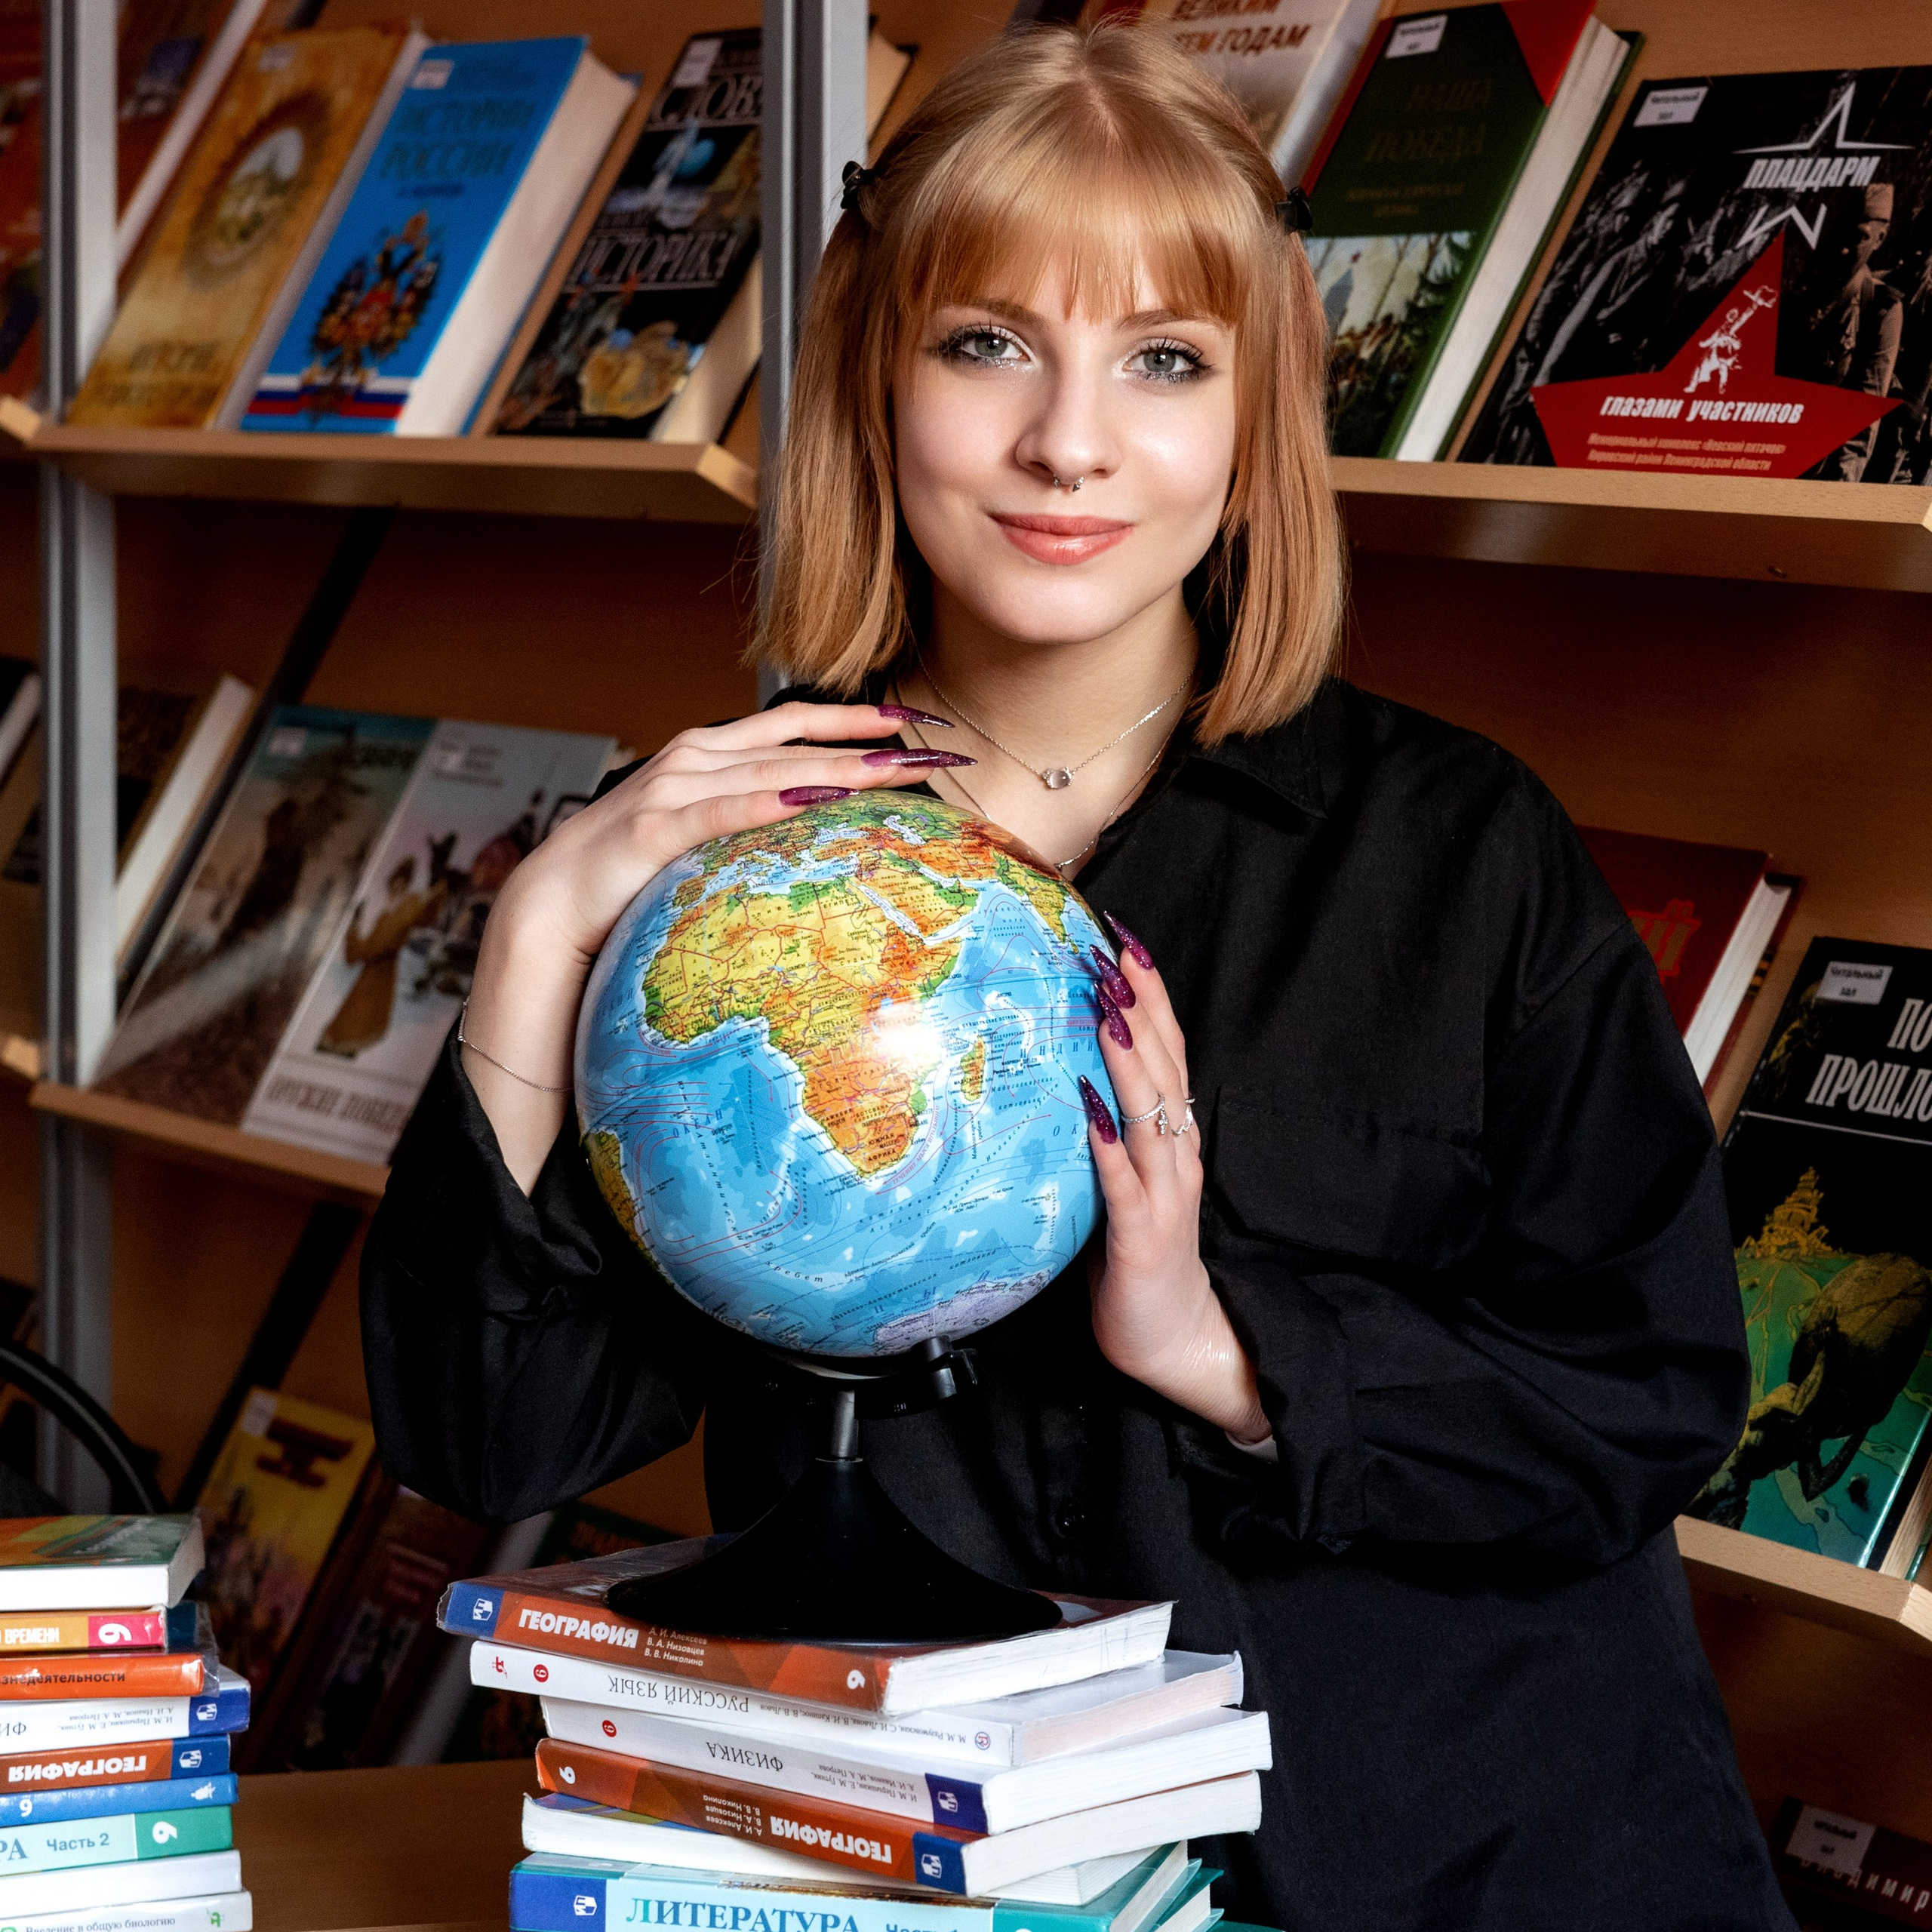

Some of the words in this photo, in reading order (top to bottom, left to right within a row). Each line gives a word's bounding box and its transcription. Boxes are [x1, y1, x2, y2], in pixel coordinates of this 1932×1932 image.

[1217, 24, 1312, 57] ГОДАМ
[1743, 156, 1881, 192] ПЛАЦДАРМ
[672, 1108, 723, 1138] ОКЕАН
[868, 1134, 895, 1145] ЮЖНАЯ
[868, 1149, 897, 1162] АФРИКА
[764, 1260, 823, 1282] хребет
[518, 1608, 640, 1649] ГЕОГРАФИЯ
[5, 1627, 60, 1644] ВРЕМЕНИ
[649, 1627, 658, 1637] А.
[660, 1629, 669, 1638] И.
[671, 1631, 708, 1645] Алексеев
[647, 1637, 654, 1646] В.
[656, 1639, 665, 1648] А.
[666, 1641, 705, 1656] Низовцев
[645, 1647, 652, 1657] В.
[654, 1650, 662, 1658] В.
[663, 1651, 704, 1666] Николина
[608, 1675, 657, 1699] ЯЗЫК
[665, 1684, 749, 1712] РУССКИЙ
[760, 1704, 781, 1715] Львов
[782, 1706, 789, 1717] В.
[791, 1709, 798, 1718] В.
[831, 1715, 840, 1725] И.
[841, 1716, 849, 1726] В.
[851, 1717, 877, 1730] Львова,
[879, 1721, 888, 1732] И.
[888, 1723, 897, 1733] С.
[899, 1724, 944, 1740] Разумовская,
[946, 1731, 955, 1742] М.
[957, 1734, 967, 1743] М.
[706, 1741, 784, 1773] ФИЗИКА
[8, 1755, 146, 1783] ГЕОГРАФИЯ
[818, 1764, 847, 1777] Петрова
[848, 1770, 855, 1778] А.
[837, 1778, 847, 1787] М.
[857, 1772, 867, 1781] М.
[868, 1774, 896, 1787] Иванов,
[848, 1780, 856, 1790] Е.
[897, 1781, 906, 1790] И.
[907, 1783, 915, 1792] А.
[897, 1791, 906, 1800] М.
[703, 1794, 743, 1811] Николина
[743, 1804, 752, 1814] В.
[705, 1804, 743, 1822] Низовцев
[752, 1807, 760, 1816] В.
[706, 1815, 742, 1832] Алексеев
[743, 1814, 752, 1824] А.
[753, 1817, 761, 1826] В.
[743, 1824, 752, 1835] И.
[754, 1826, 762, 1836] А.
[47, 1836, 95, 1852] Часть
[100, 1832, 109, 1846] 2
[770, 1816, 892, 1864] ГЕОГРАФИЯ
[626, 1897, 859, 1932] ЛИТЕРАТУРА
[86, 1921, 123, 1932] общую
[125, 1916, 176, 1930] биологию
